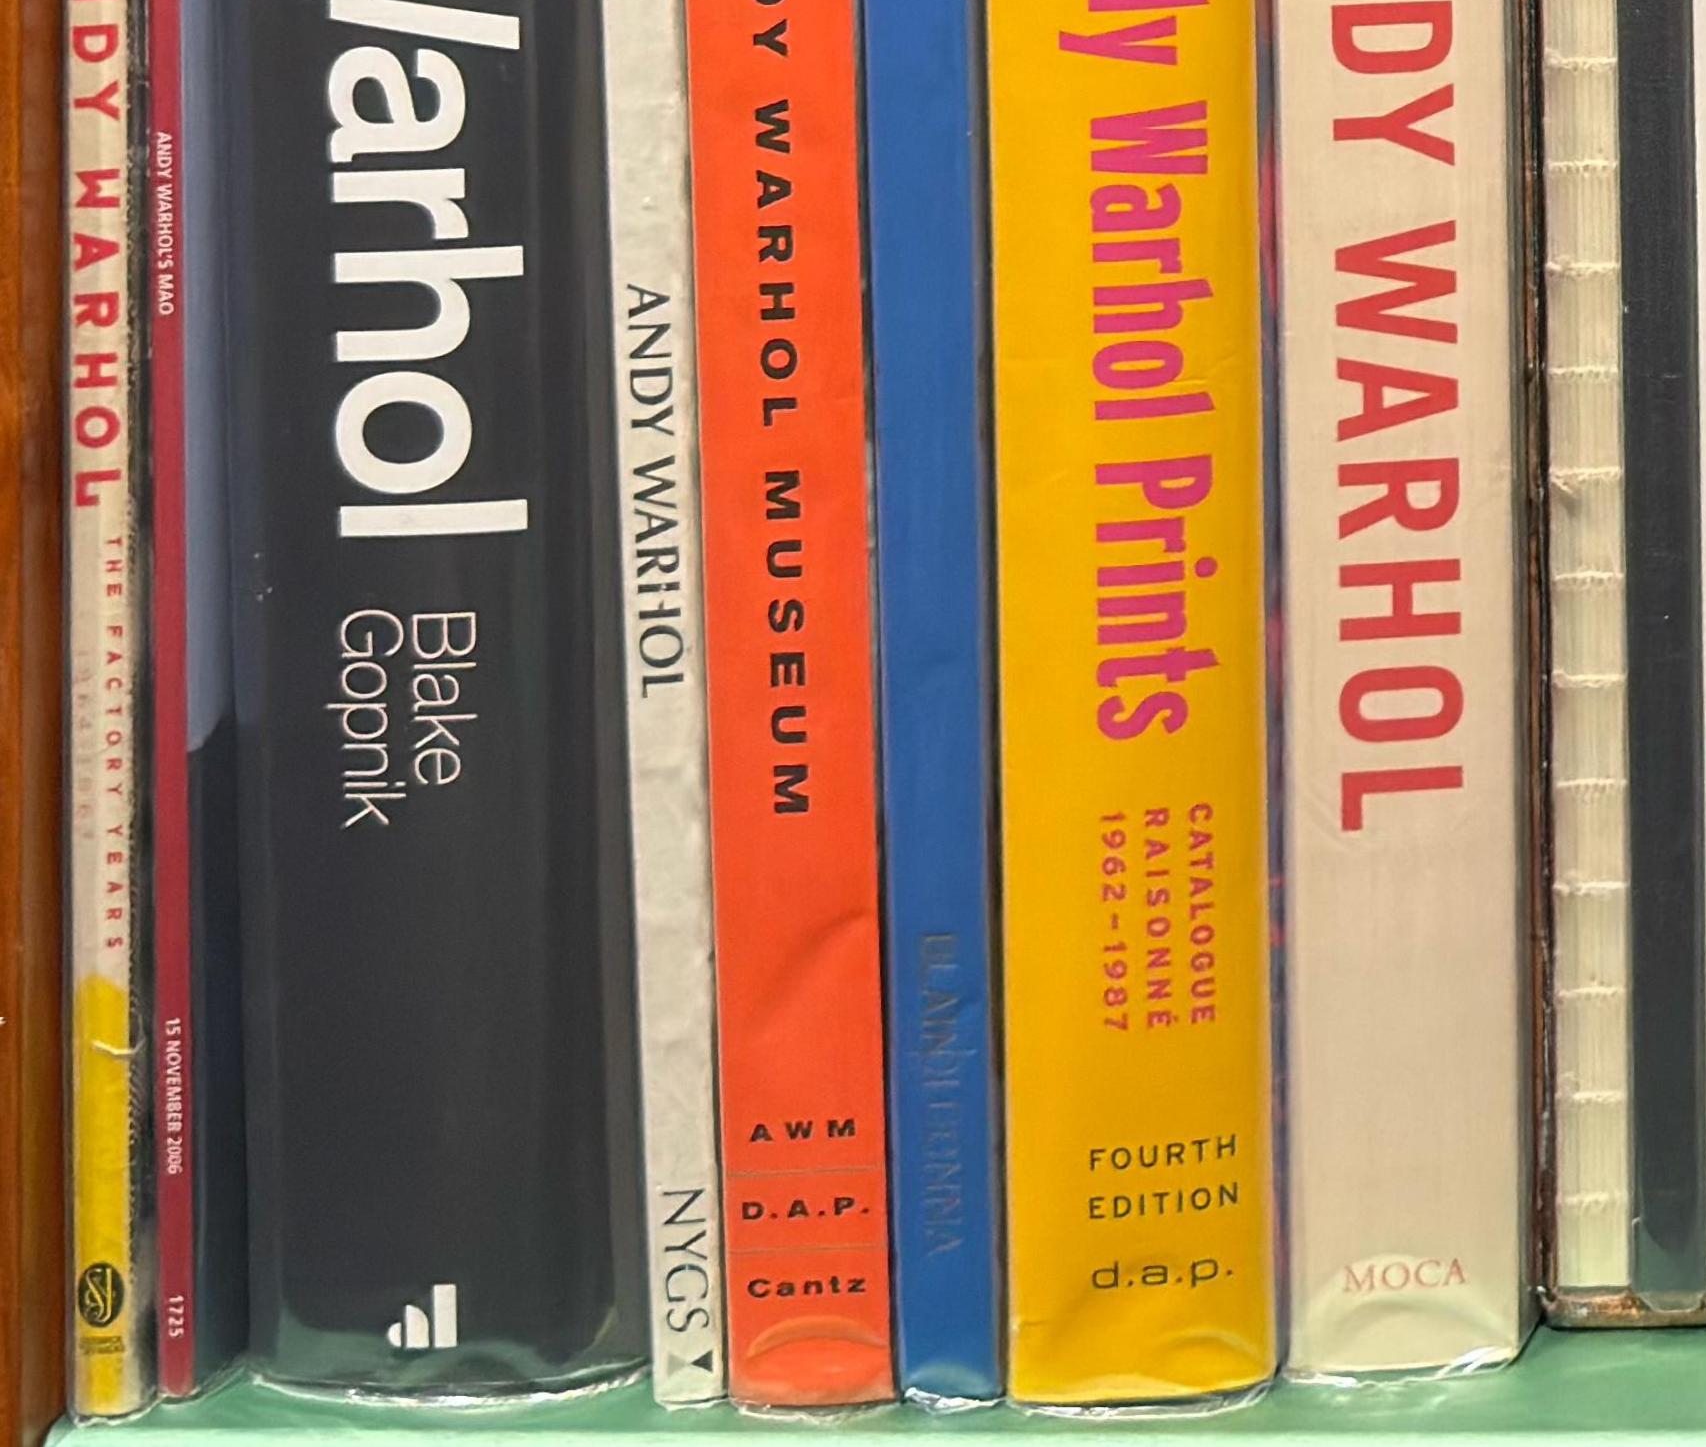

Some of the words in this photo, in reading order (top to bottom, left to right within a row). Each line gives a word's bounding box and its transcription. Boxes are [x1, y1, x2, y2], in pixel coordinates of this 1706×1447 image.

[156, 131, 173, 177] ANDY
[157, 277, 174, 316] MAO
[754, 98, 798, 426] WARHOL
[1090, 101, 1215, 421] Warhol
[72, 166, 121, 506] WARHOL
[627, 284, 673, 436] ANDY
[106, 536, 123, 596] THE
[633, 454, 685, 698] WARHOL
[1097, 454, 1220, 741] Prints
[1333, 222, 1464, 831] WARHOL
[106, 625, 123, 796] FACTORY
[410, 610, 477, 785] Blake
[764, 470, 812, 815] MUSEUM
[326, 610, 407, 829] Gopnik
[106, 825, 123, 949] YEARS
[1145, 808, 1180, 1029] RAISONNÉ
[1187, 803, 1216, 1023] CATALOGUE
[166, 1017, 182, 1035] 15
[166, 1041, 182, 1131] NOVEMBER
[743, 1198, 871, 1221] D.A.P.
[1089, 1182, 1240, 1220] EDITION
[1090, 1134, 1238, 1172] FOURTH
[168, 1294, 184, 1337] 1725
[656, 1189, 712, 1332] NYGS
[748, 1274, 867, 1299] Cantz
[1092, 1257, 1233, 1290] d.a.p.
[1341, 1258, 1467, 1293] MOCA
